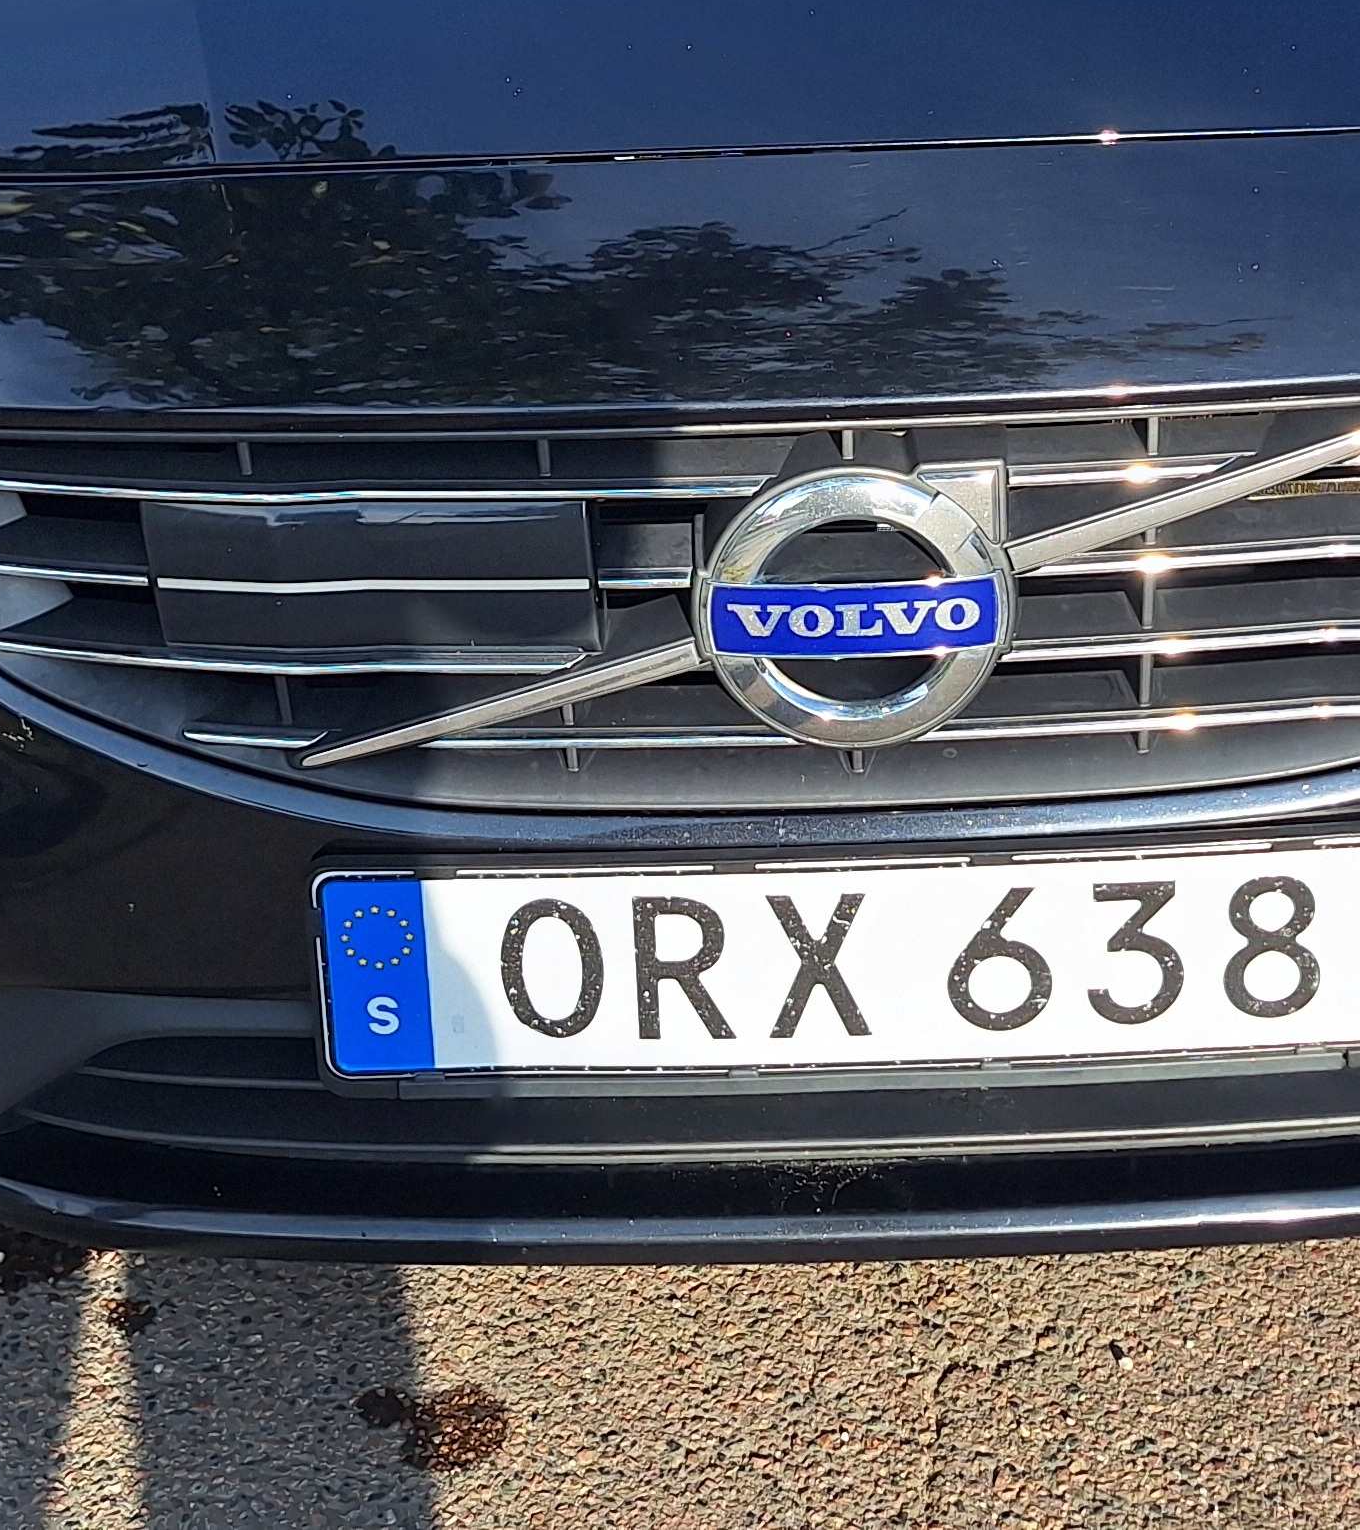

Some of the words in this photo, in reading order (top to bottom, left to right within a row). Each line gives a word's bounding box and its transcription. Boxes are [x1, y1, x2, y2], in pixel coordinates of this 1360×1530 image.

[727, 597, 981, 637] VOLVO
[500, 892, 873, 1039] ORX
[947, 875, 1321, 1031] 638
[366, 995, 400, 1035] S
